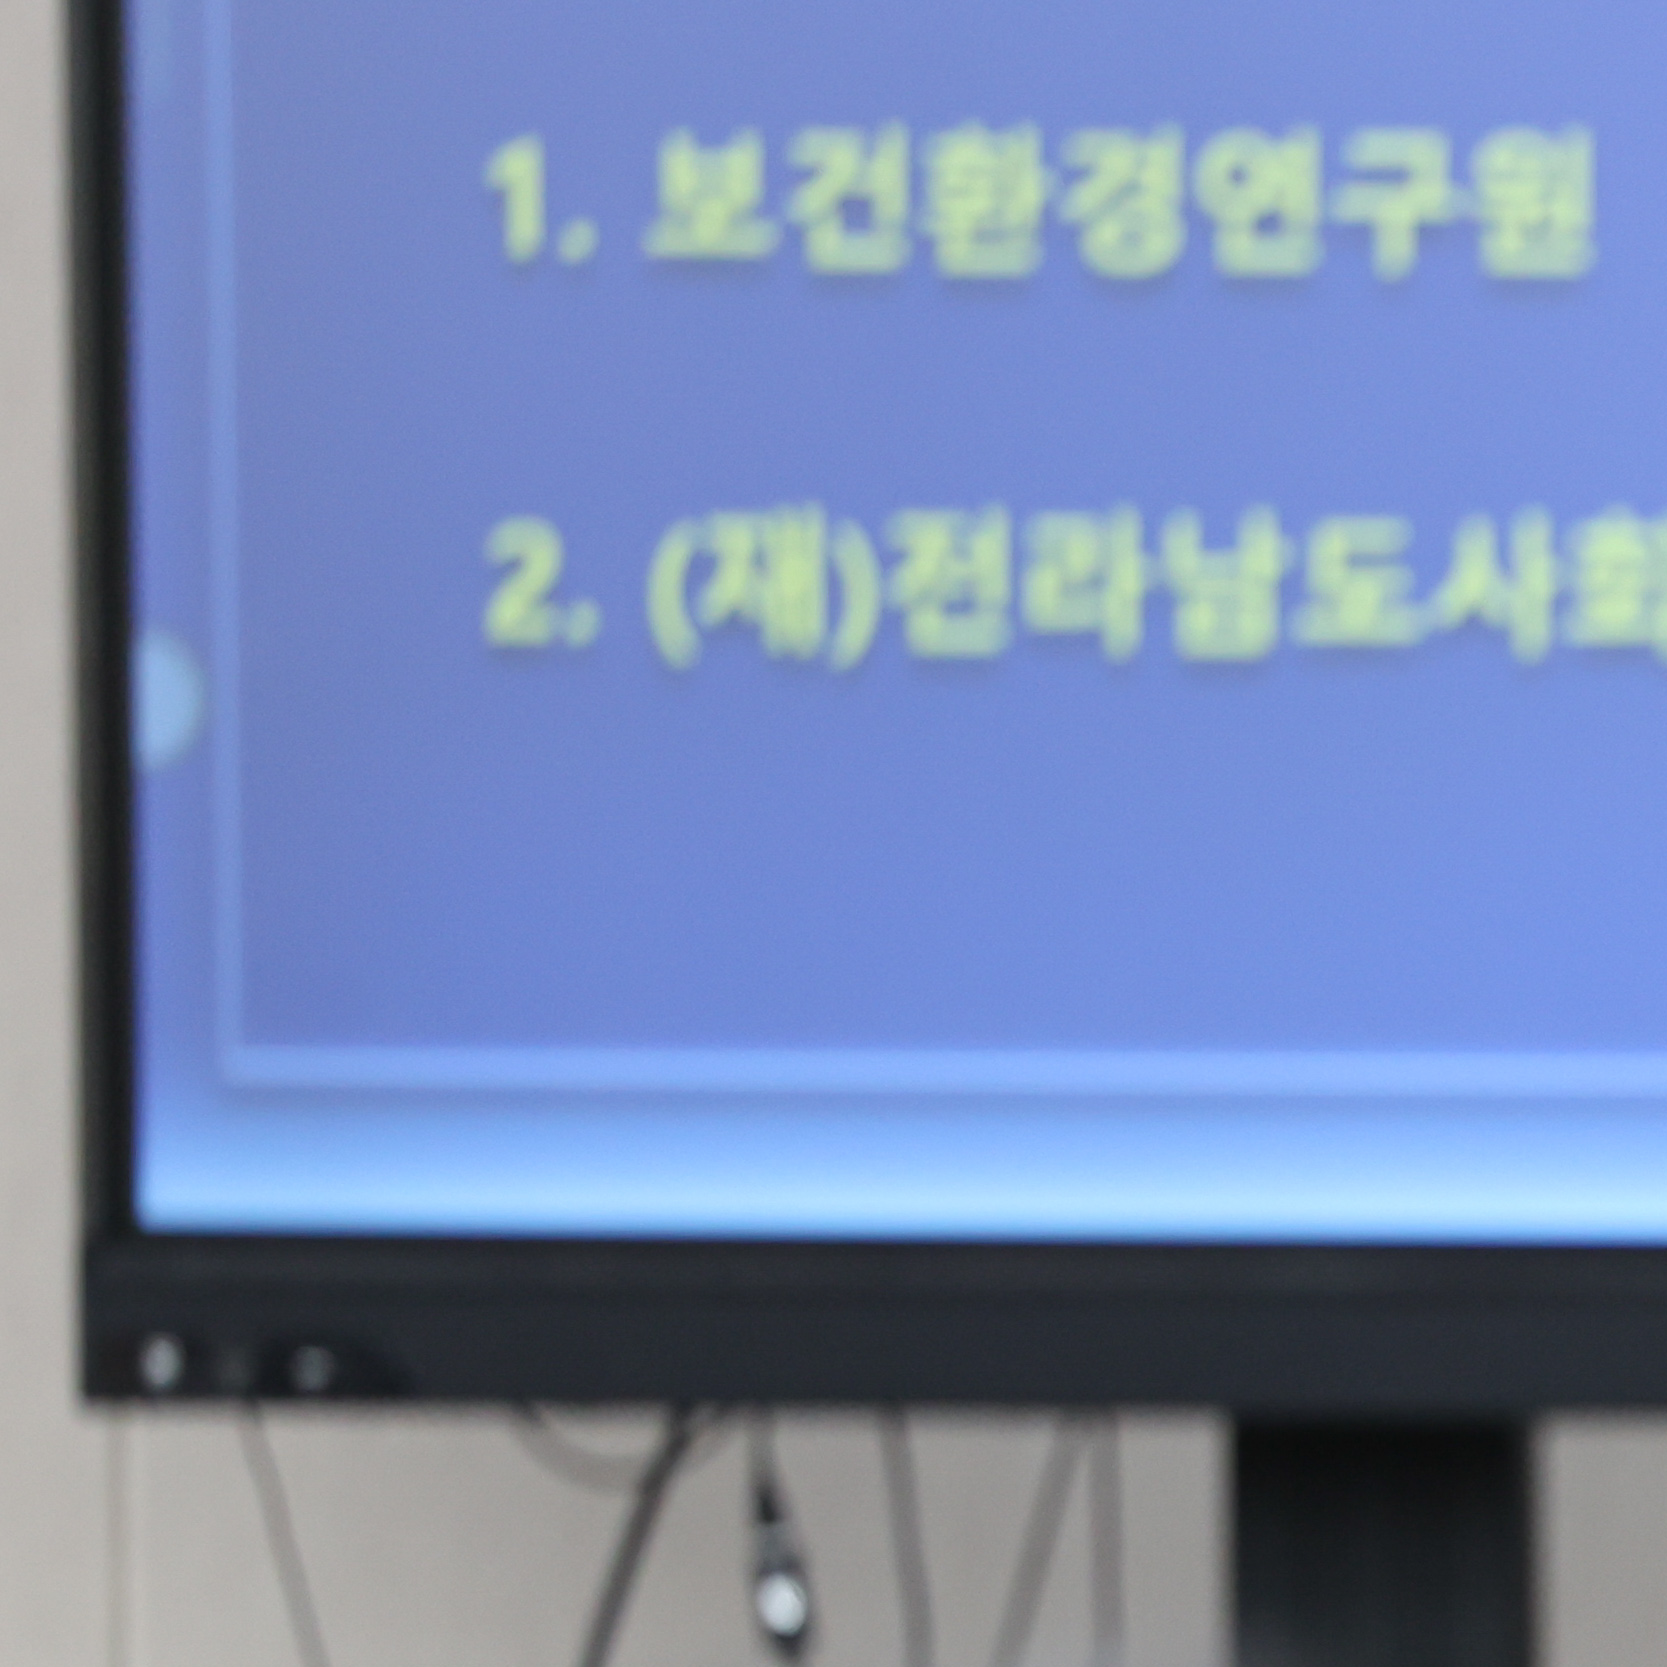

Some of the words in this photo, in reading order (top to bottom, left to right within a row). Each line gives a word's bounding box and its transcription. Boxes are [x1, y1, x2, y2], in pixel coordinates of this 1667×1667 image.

[490, 138, 592, 258] 1.
[650, 127, 1591, 276] 보건환경연구원
[488, 520, 595, 644] 2.
